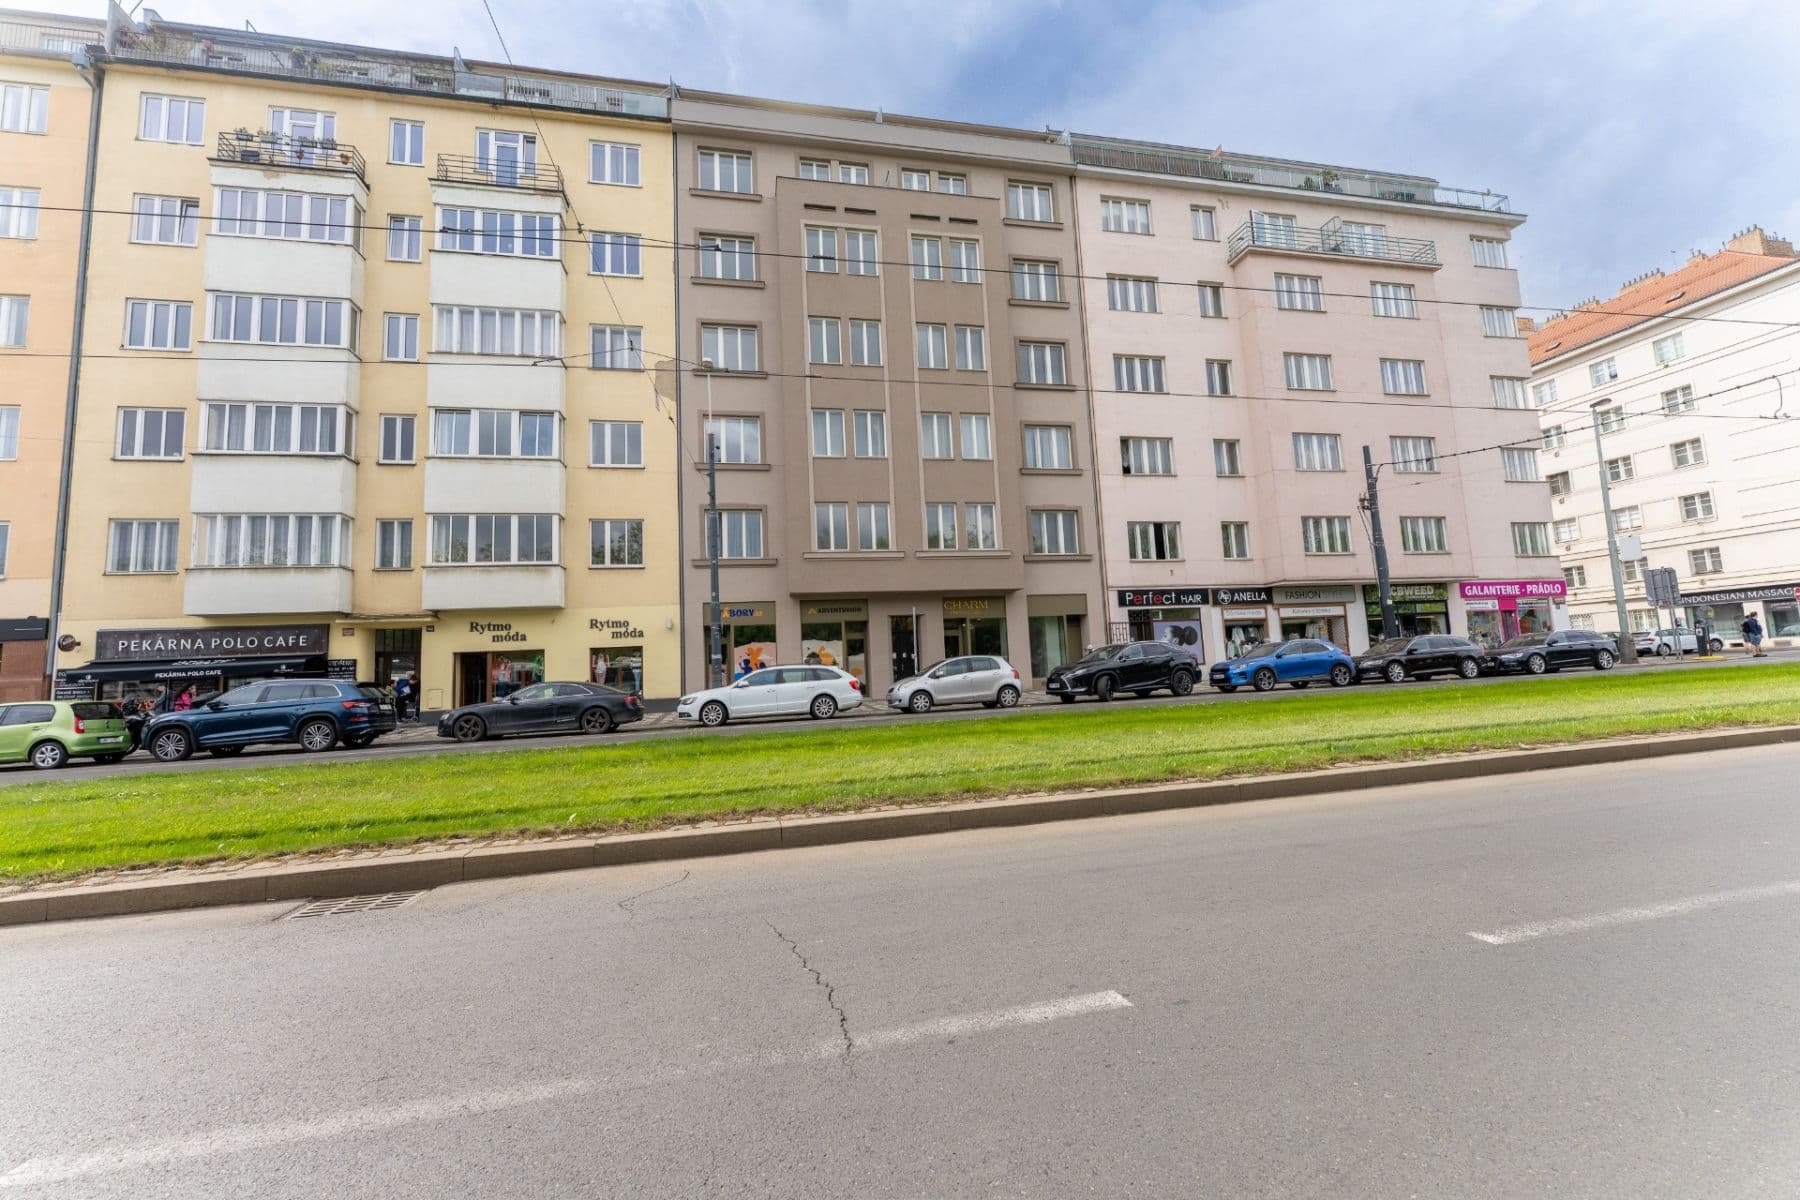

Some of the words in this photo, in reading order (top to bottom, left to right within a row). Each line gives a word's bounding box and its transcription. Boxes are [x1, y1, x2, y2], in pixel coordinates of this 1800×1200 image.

[1464, 585, 1521, 596] GALANTERIE
[1526, 582, 1562, 595] PRÁDLO
[1125, 591, 1177, 605] Perfect
[1180, 593, 1202, 604] HAIR
[1233, 591, 1268, 602] ANELLA
[1284, 590, 1321, 601] FASHION
[1681, 593, 1745, 604] INDONESIAN
[1747, 587, 1793, 598] MASSAG
[943, 599, 988, 609] CHARM
[469, 621, 512, 635] Rytmo
[590, 618, 630, 631] Rytmo
[491, 631, 528, 643] móda
[611, 628, 645, 640] móda
[118, 636, 205, 652] PEKÁRNA
[211, 637, 258, 649] POLO
[264, 635, 308, 647] CAFE
[155, 671, 186, 679] PEKÁRNA
